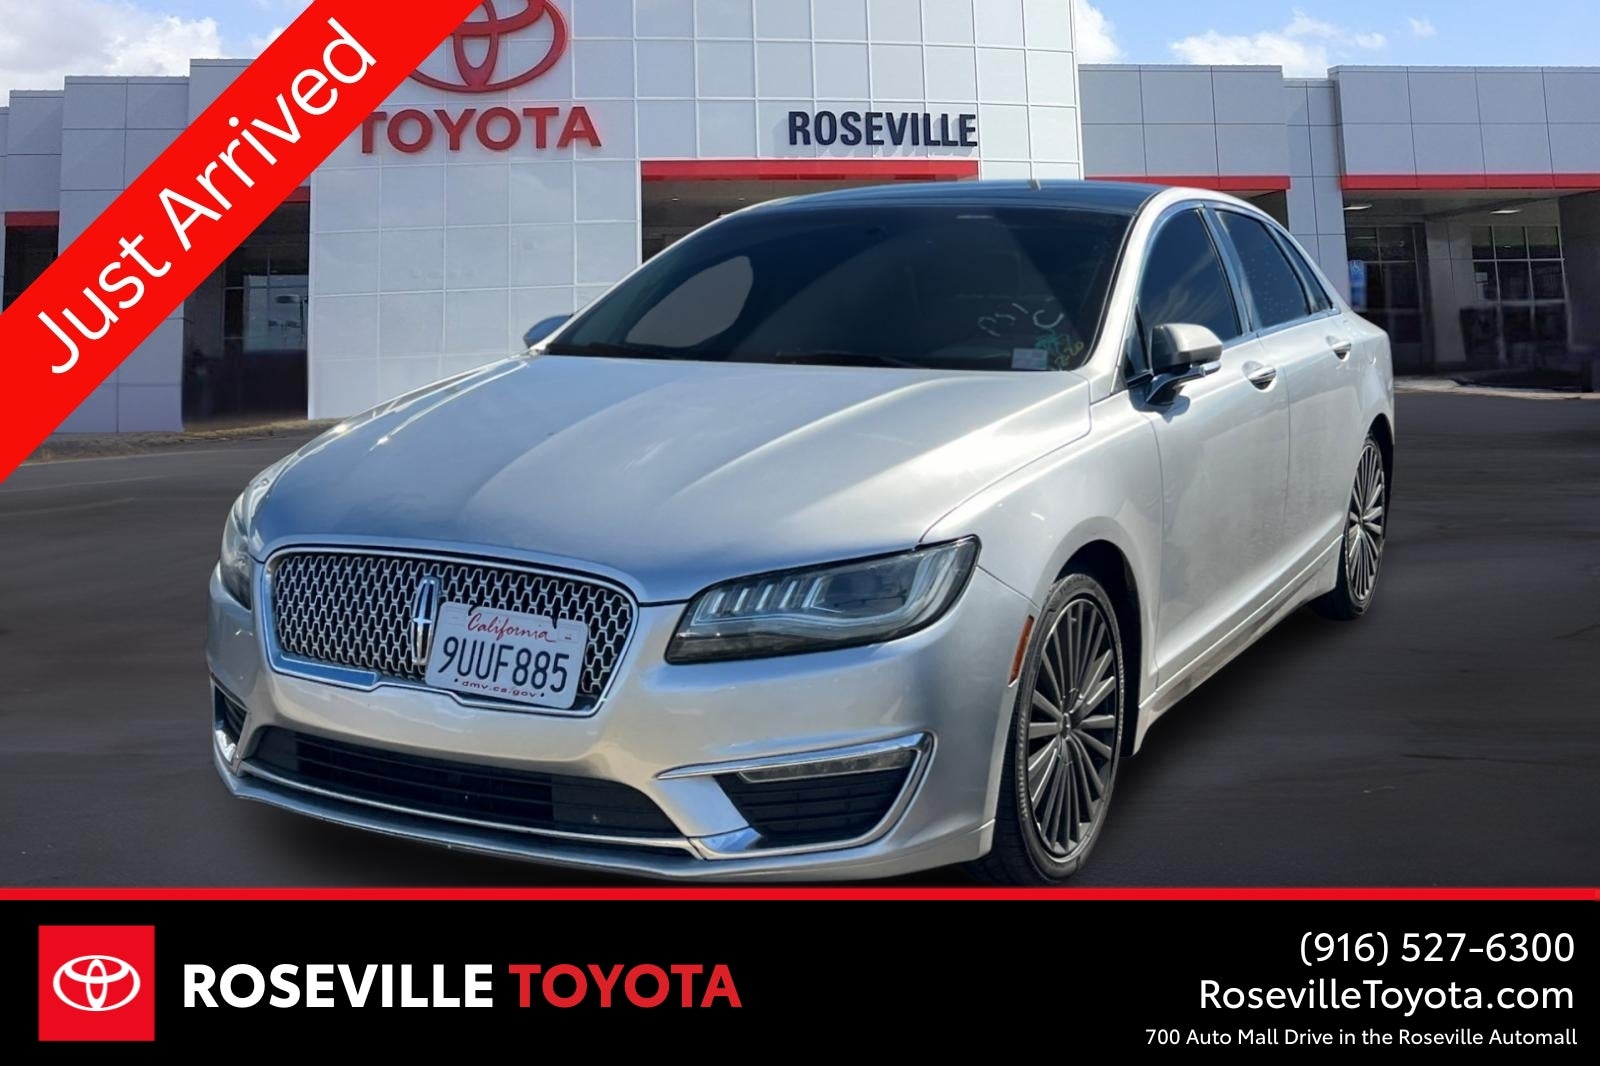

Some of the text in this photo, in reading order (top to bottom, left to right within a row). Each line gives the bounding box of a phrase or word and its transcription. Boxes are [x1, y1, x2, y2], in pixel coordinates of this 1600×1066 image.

[361, 106, 602, 154] TOYOTA
[788, 110, 978, 147] ROSEVILLE
[467, 612, 557, 643] California
[438, 636, 570, 693] 9UUF885
[461, 680, 537, 698] dmv.ca.gov
